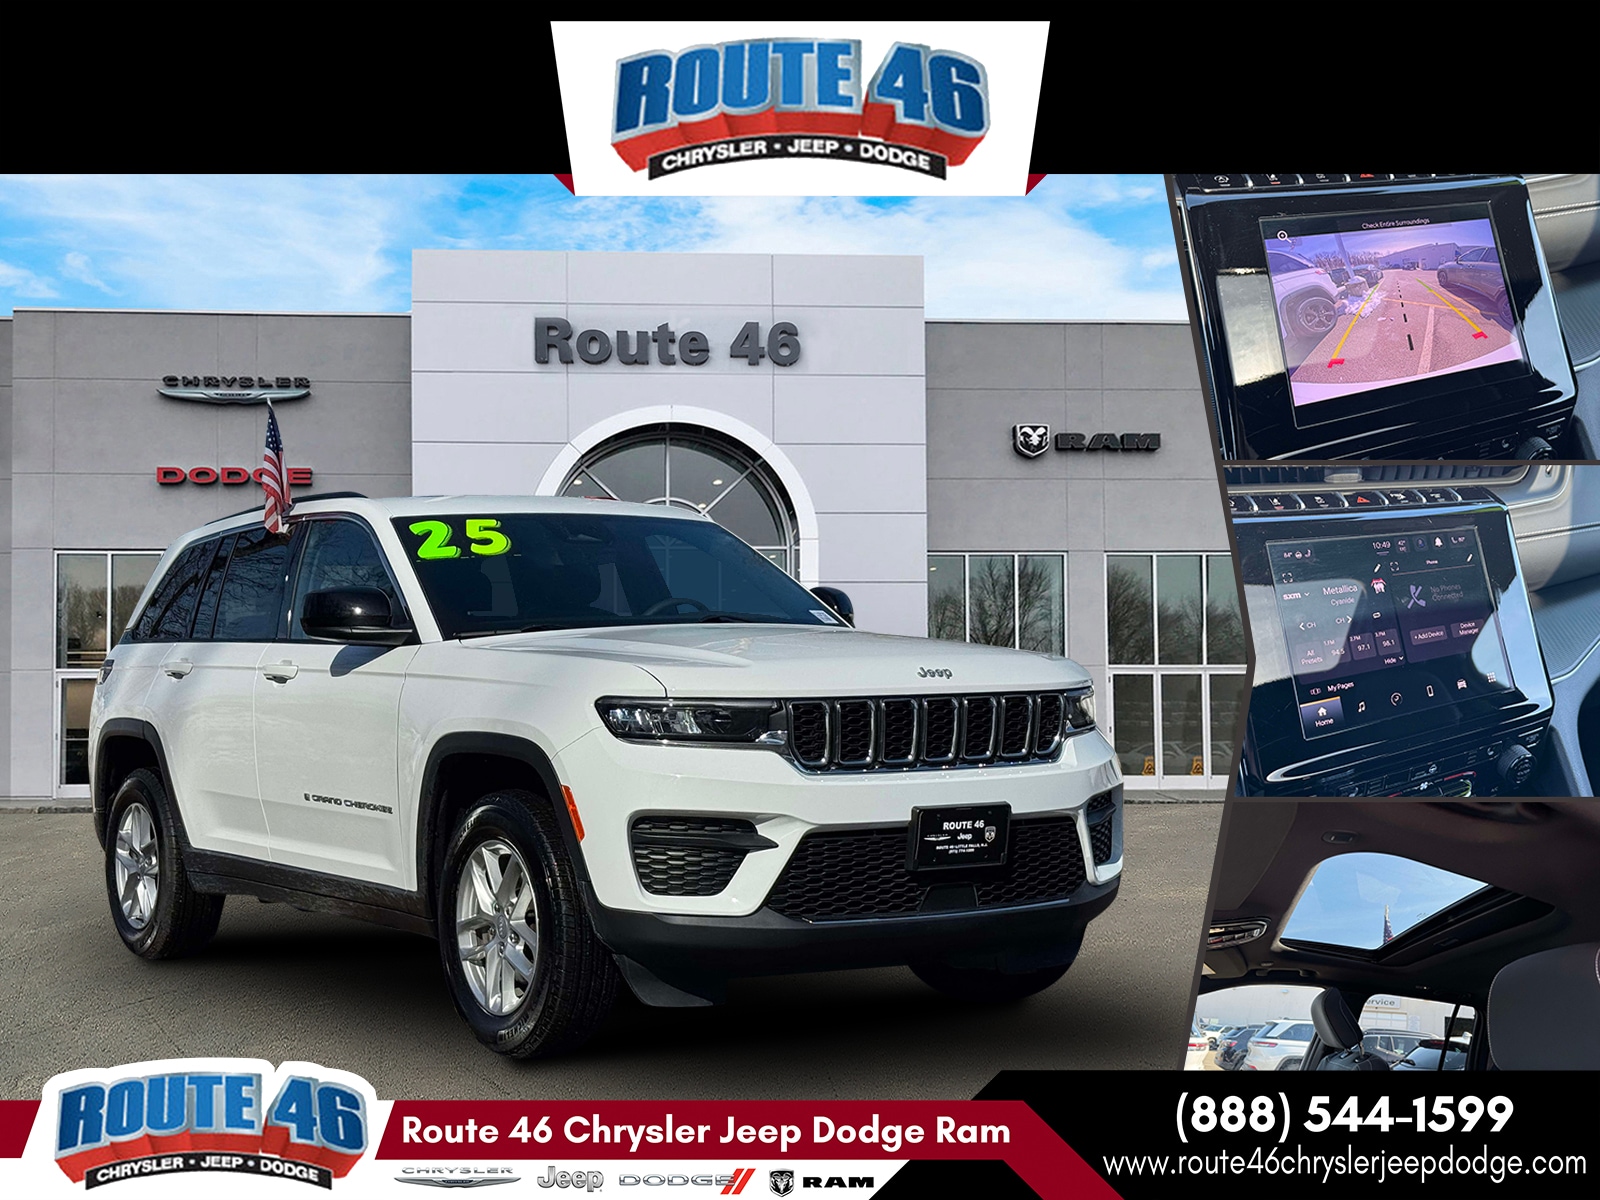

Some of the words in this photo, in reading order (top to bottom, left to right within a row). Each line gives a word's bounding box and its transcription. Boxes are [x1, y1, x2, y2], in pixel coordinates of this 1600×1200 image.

[1396, 218, 1430, 226] Surroundings
[534, 317, 711, 365] Route
[729, 321, 802, 367] 46
[162, 375, 311, 388] CHRYSLER
[1055, 433, 1161, 452] RAM
[408, 519, 513, 560] 25
[1372, 540, 1391, 550] 10:49
[1322, 584, 1359, 596] Metallica
[1282, 592, 1302, 600] sxm
[1330, 596, 1355, 606] Cyanide
[1306, 621, 1317, 629] CH
[1335, 617, 1345, 625] CH
[1459, 621, 1476, 629] Device
[1418, 632, 1428, 640] Add
[1427, 629, 1445, 638] Device
[1458, 626, 1479, 636] Manager
[1357, 643, 1371, 651] 97.1
[1301, 656, 1323, 665] Presets
[1384, 657, 1397, 665] Hide
[917, 666, 953, 680] Jeep
[1327, 684, 1337, 693] My
[1337, 681, 1355, 691] Pages
[1315, 717, 1334, 727] Home
[311, 794, 342, 806] GRAND
[343, 799, 393, 814] CHEROKEE
[943, 821, 972, 830] ROUTE
[974, 820, 985, 828] 46
[957, 832, 972, 840] Jeep
